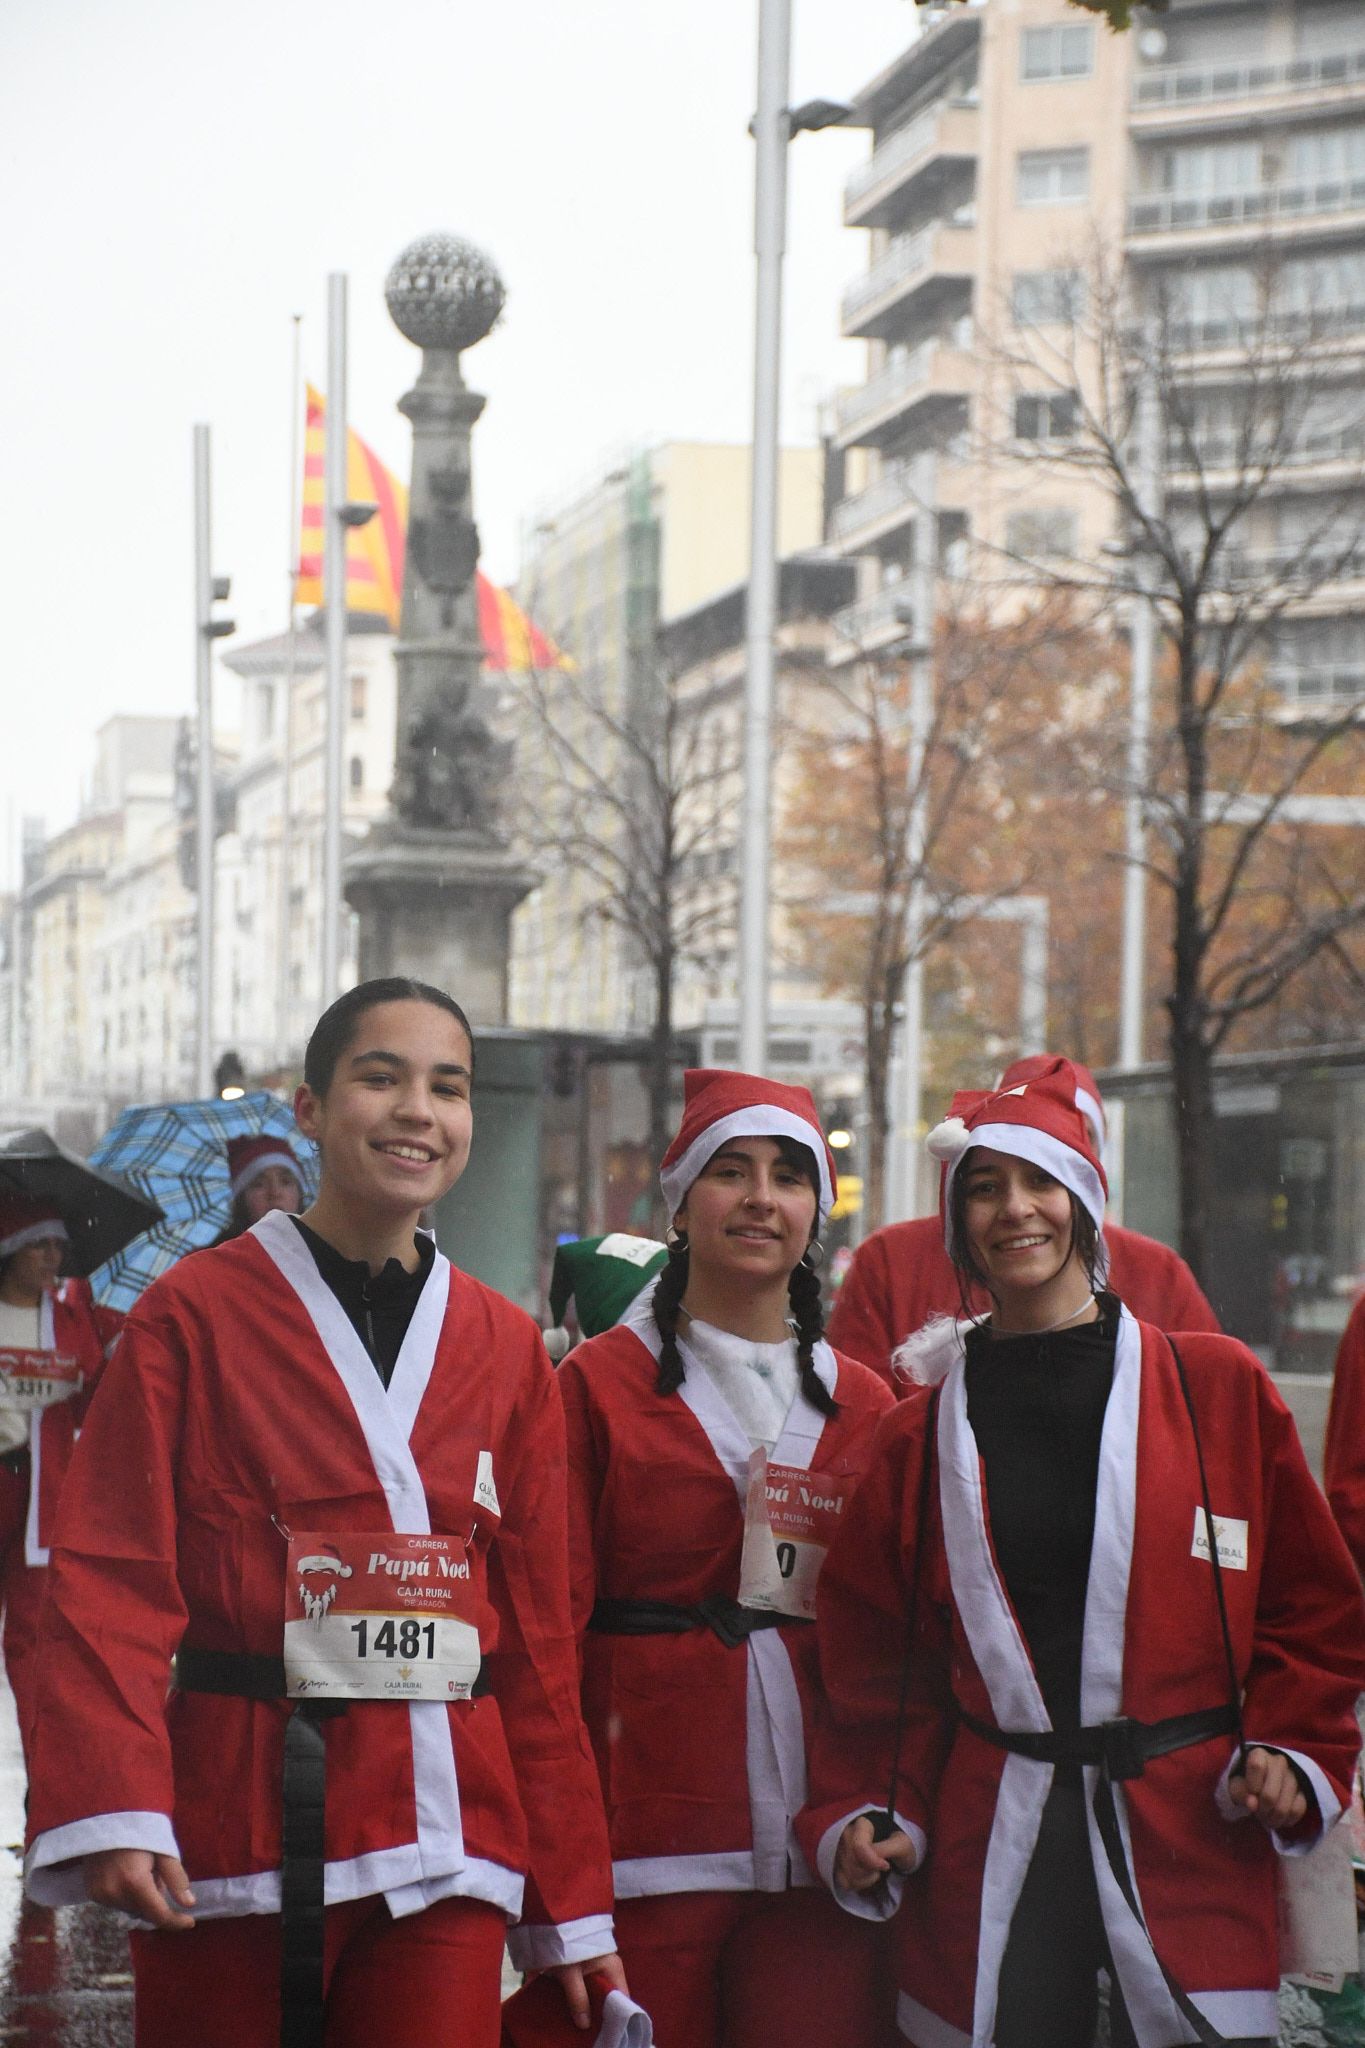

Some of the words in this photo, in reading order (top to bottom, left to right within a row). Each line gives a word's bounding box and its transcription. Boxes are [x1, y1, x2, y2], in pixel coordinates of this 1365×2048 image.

[768, 1468, 812, 1482] CARRERA
[795, 1486, 843, 1515] Noel
[783, 1512, 816, 1527] RURAL
[407, 1539, 449, 1551] CARRERA
[366, 1553, 430, 1582] Papá
[436, 1555, 471, 1580] Noel
[397, 1586, 424, 1598] CAJA
[425, 1587, 453, 1599] RURAL
[404, 1599, 416, 1607] DE
[350, 1619, 436, 1660] 1481
